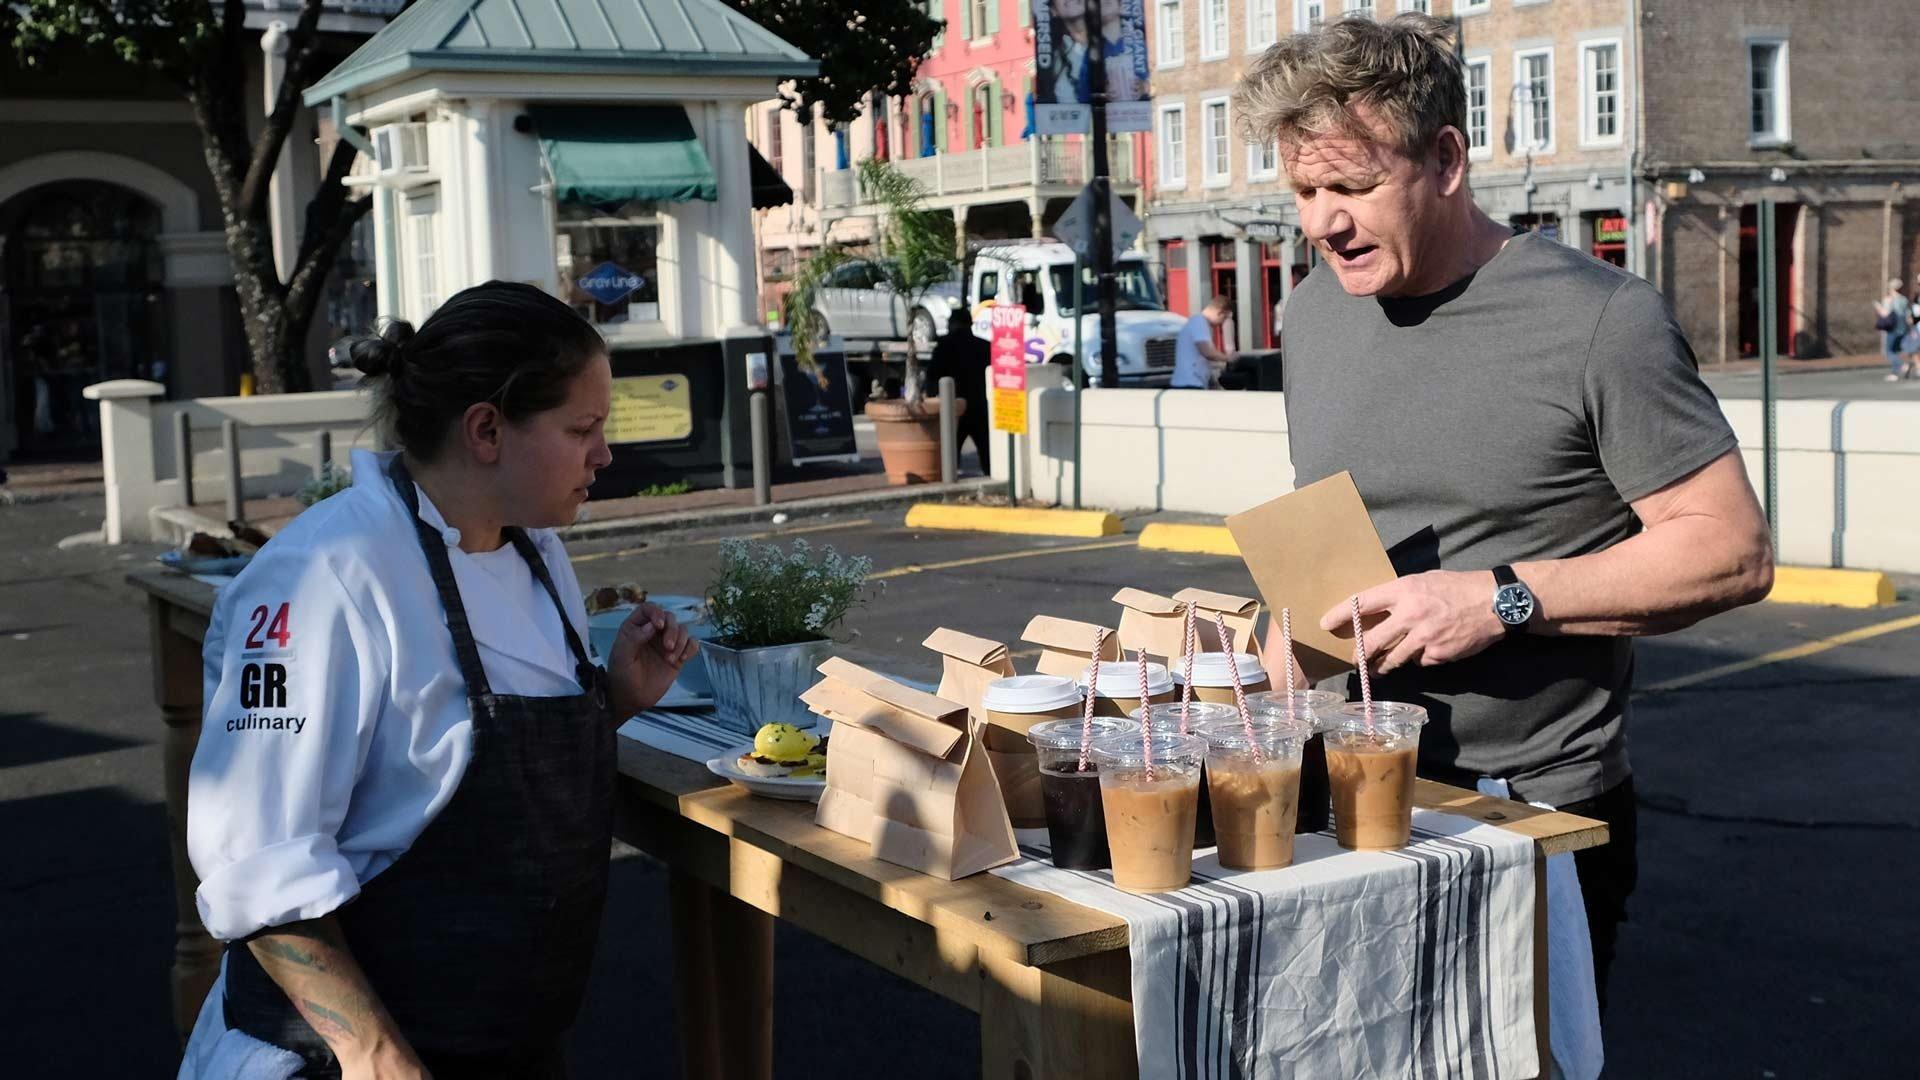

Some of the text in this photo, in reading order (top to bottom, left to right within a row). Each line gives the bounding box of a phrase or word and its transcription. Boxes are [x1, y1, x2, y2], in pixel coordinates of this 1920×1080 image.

[993, 307, 1023, 328] STOP
[245, 602, 291, 650] 24
[240, 663, 287, 709] GR
[226, 714, 307, 734] culinary
